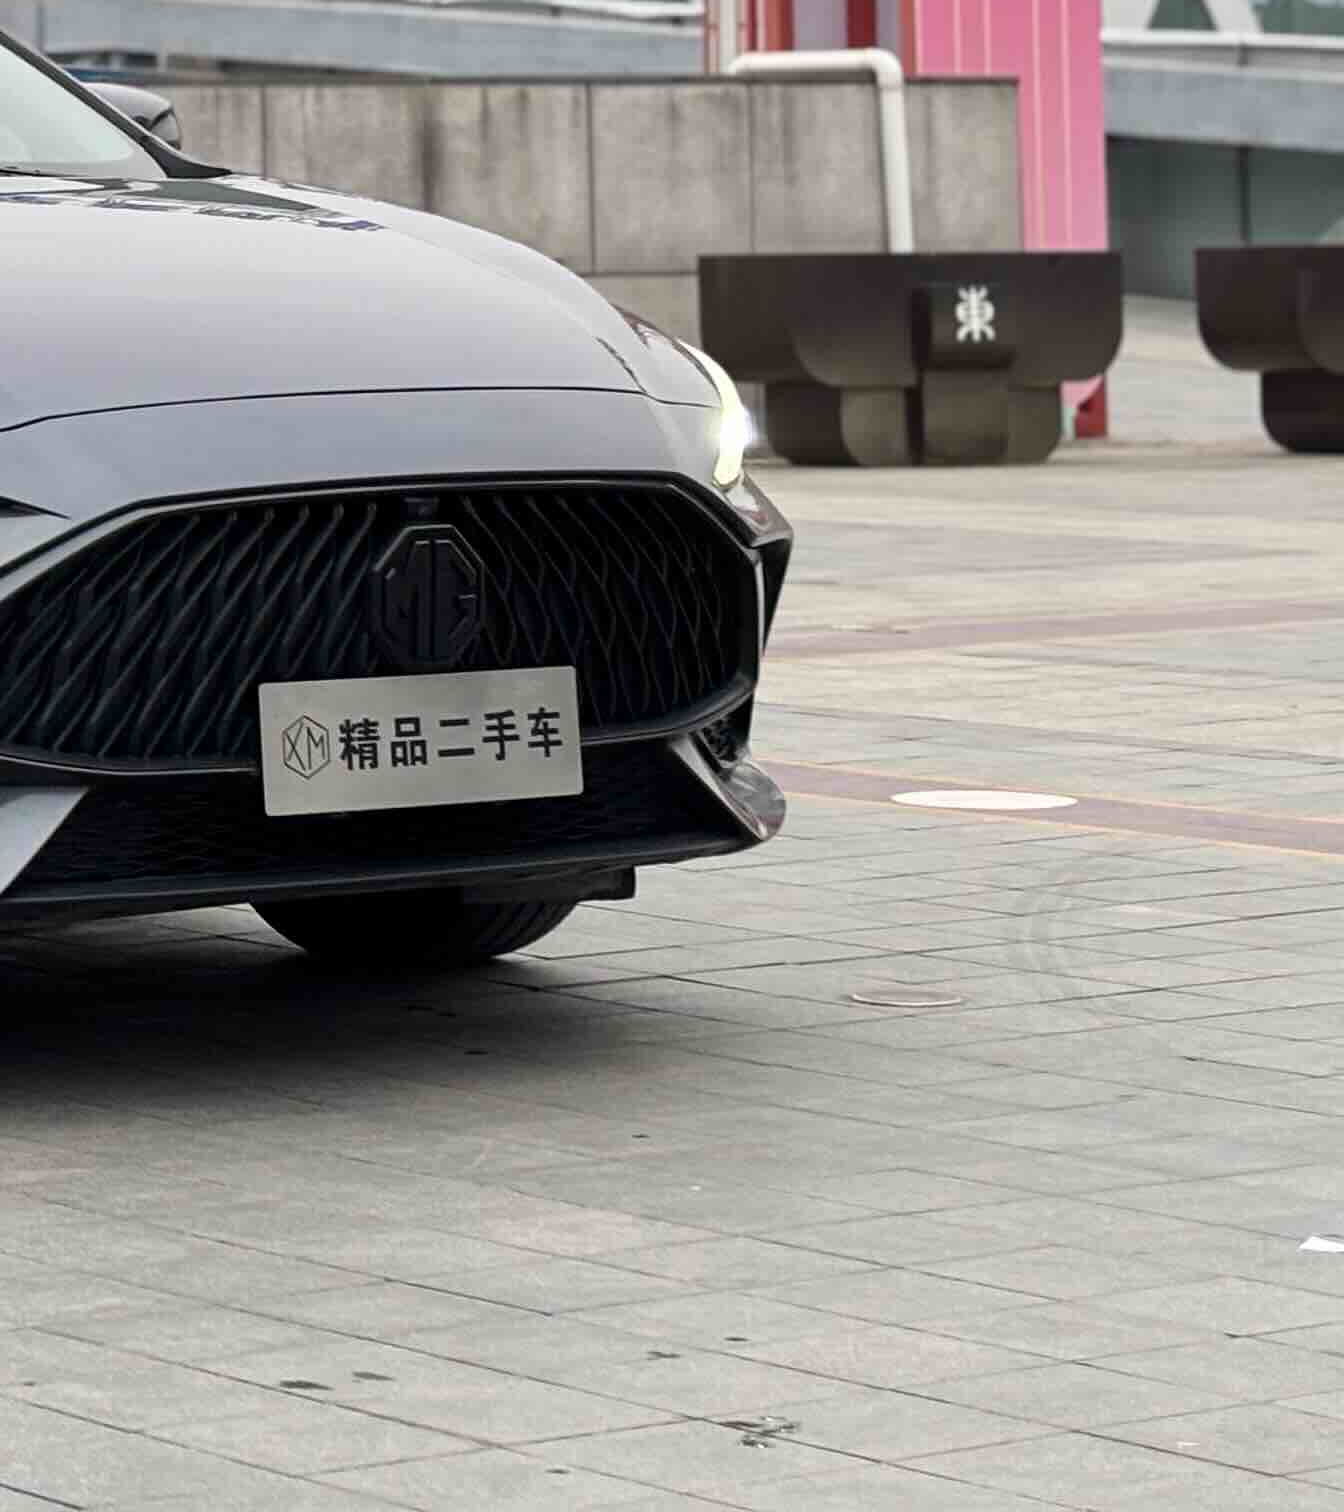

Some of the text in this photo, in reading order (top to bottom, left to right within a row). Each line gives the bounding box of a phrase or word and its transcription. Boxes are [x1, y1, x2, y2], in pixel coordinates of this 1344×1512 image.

[338, 706, 564, 771] 精品二手车
